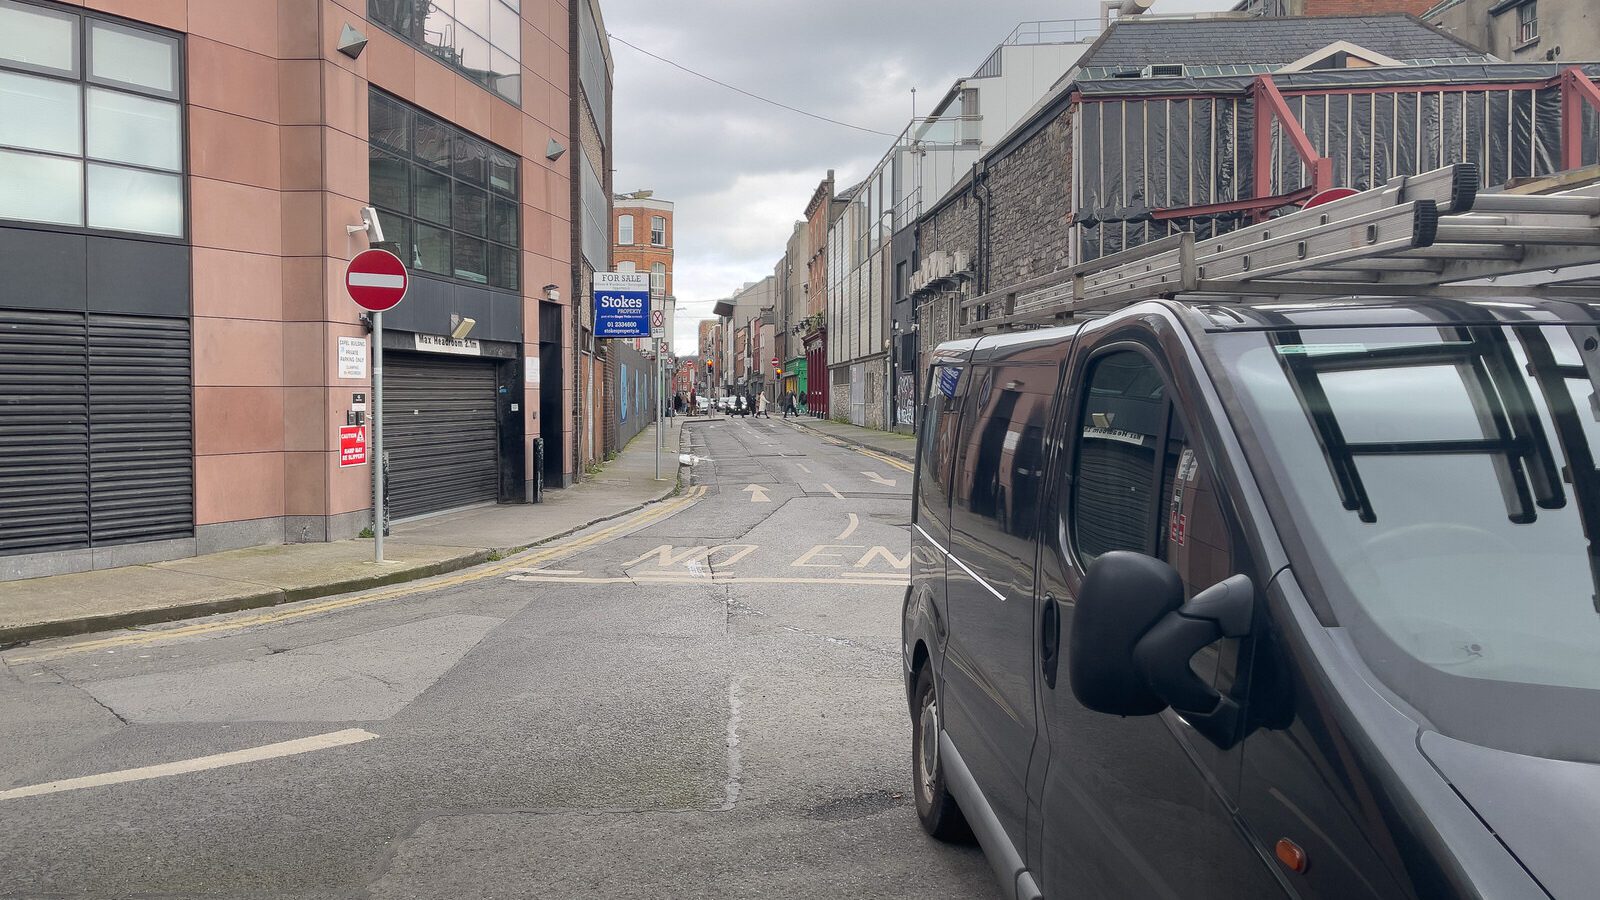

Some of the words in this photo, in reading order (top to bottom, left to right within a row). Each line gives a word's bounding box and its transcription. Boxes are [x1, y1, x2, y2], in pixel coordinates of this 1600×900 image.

[602, 274, 620, 282] FOR
[621, 275, 641, 283] SALE
[601, 295, 643, 308] Stokes
[418, 334, 431, 344] Max
[433, 336, 463, 348] Headroom
[620, 544, 759, 567] NO
